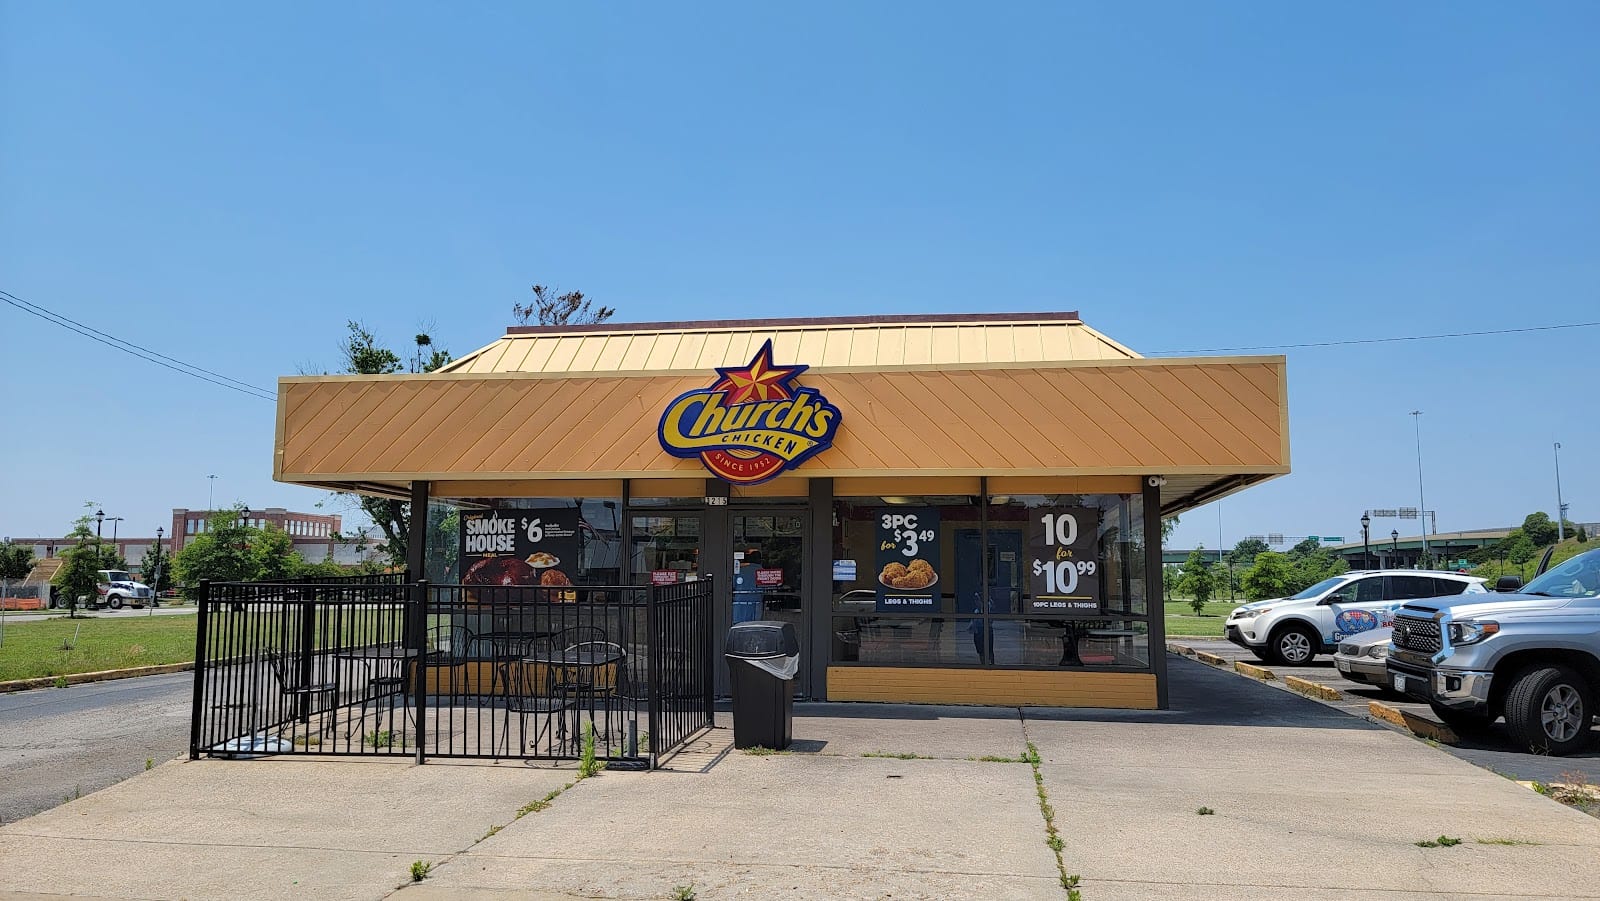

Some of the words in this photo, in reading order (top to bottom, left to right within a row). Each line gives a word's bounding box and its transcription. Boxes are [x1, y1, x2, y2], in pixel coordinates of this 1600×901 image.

[663, 391, 833, 449] Church's
[721, 433, 799, 456] CHICKEN
[715, 453, 745, 472] SINCE
[749, 457, 771, 472] 1952
[466, 519, 515, 535] SMOKE
[521, 517, 543, 543] $6
[881, 514, 918, 529] 3PC
[1041, 513, 1078, 546] 10
[465, 535, 515, 552] HOUSE
[881, 540, 896, 551] for
[1056, 546, 1073, 560] for
